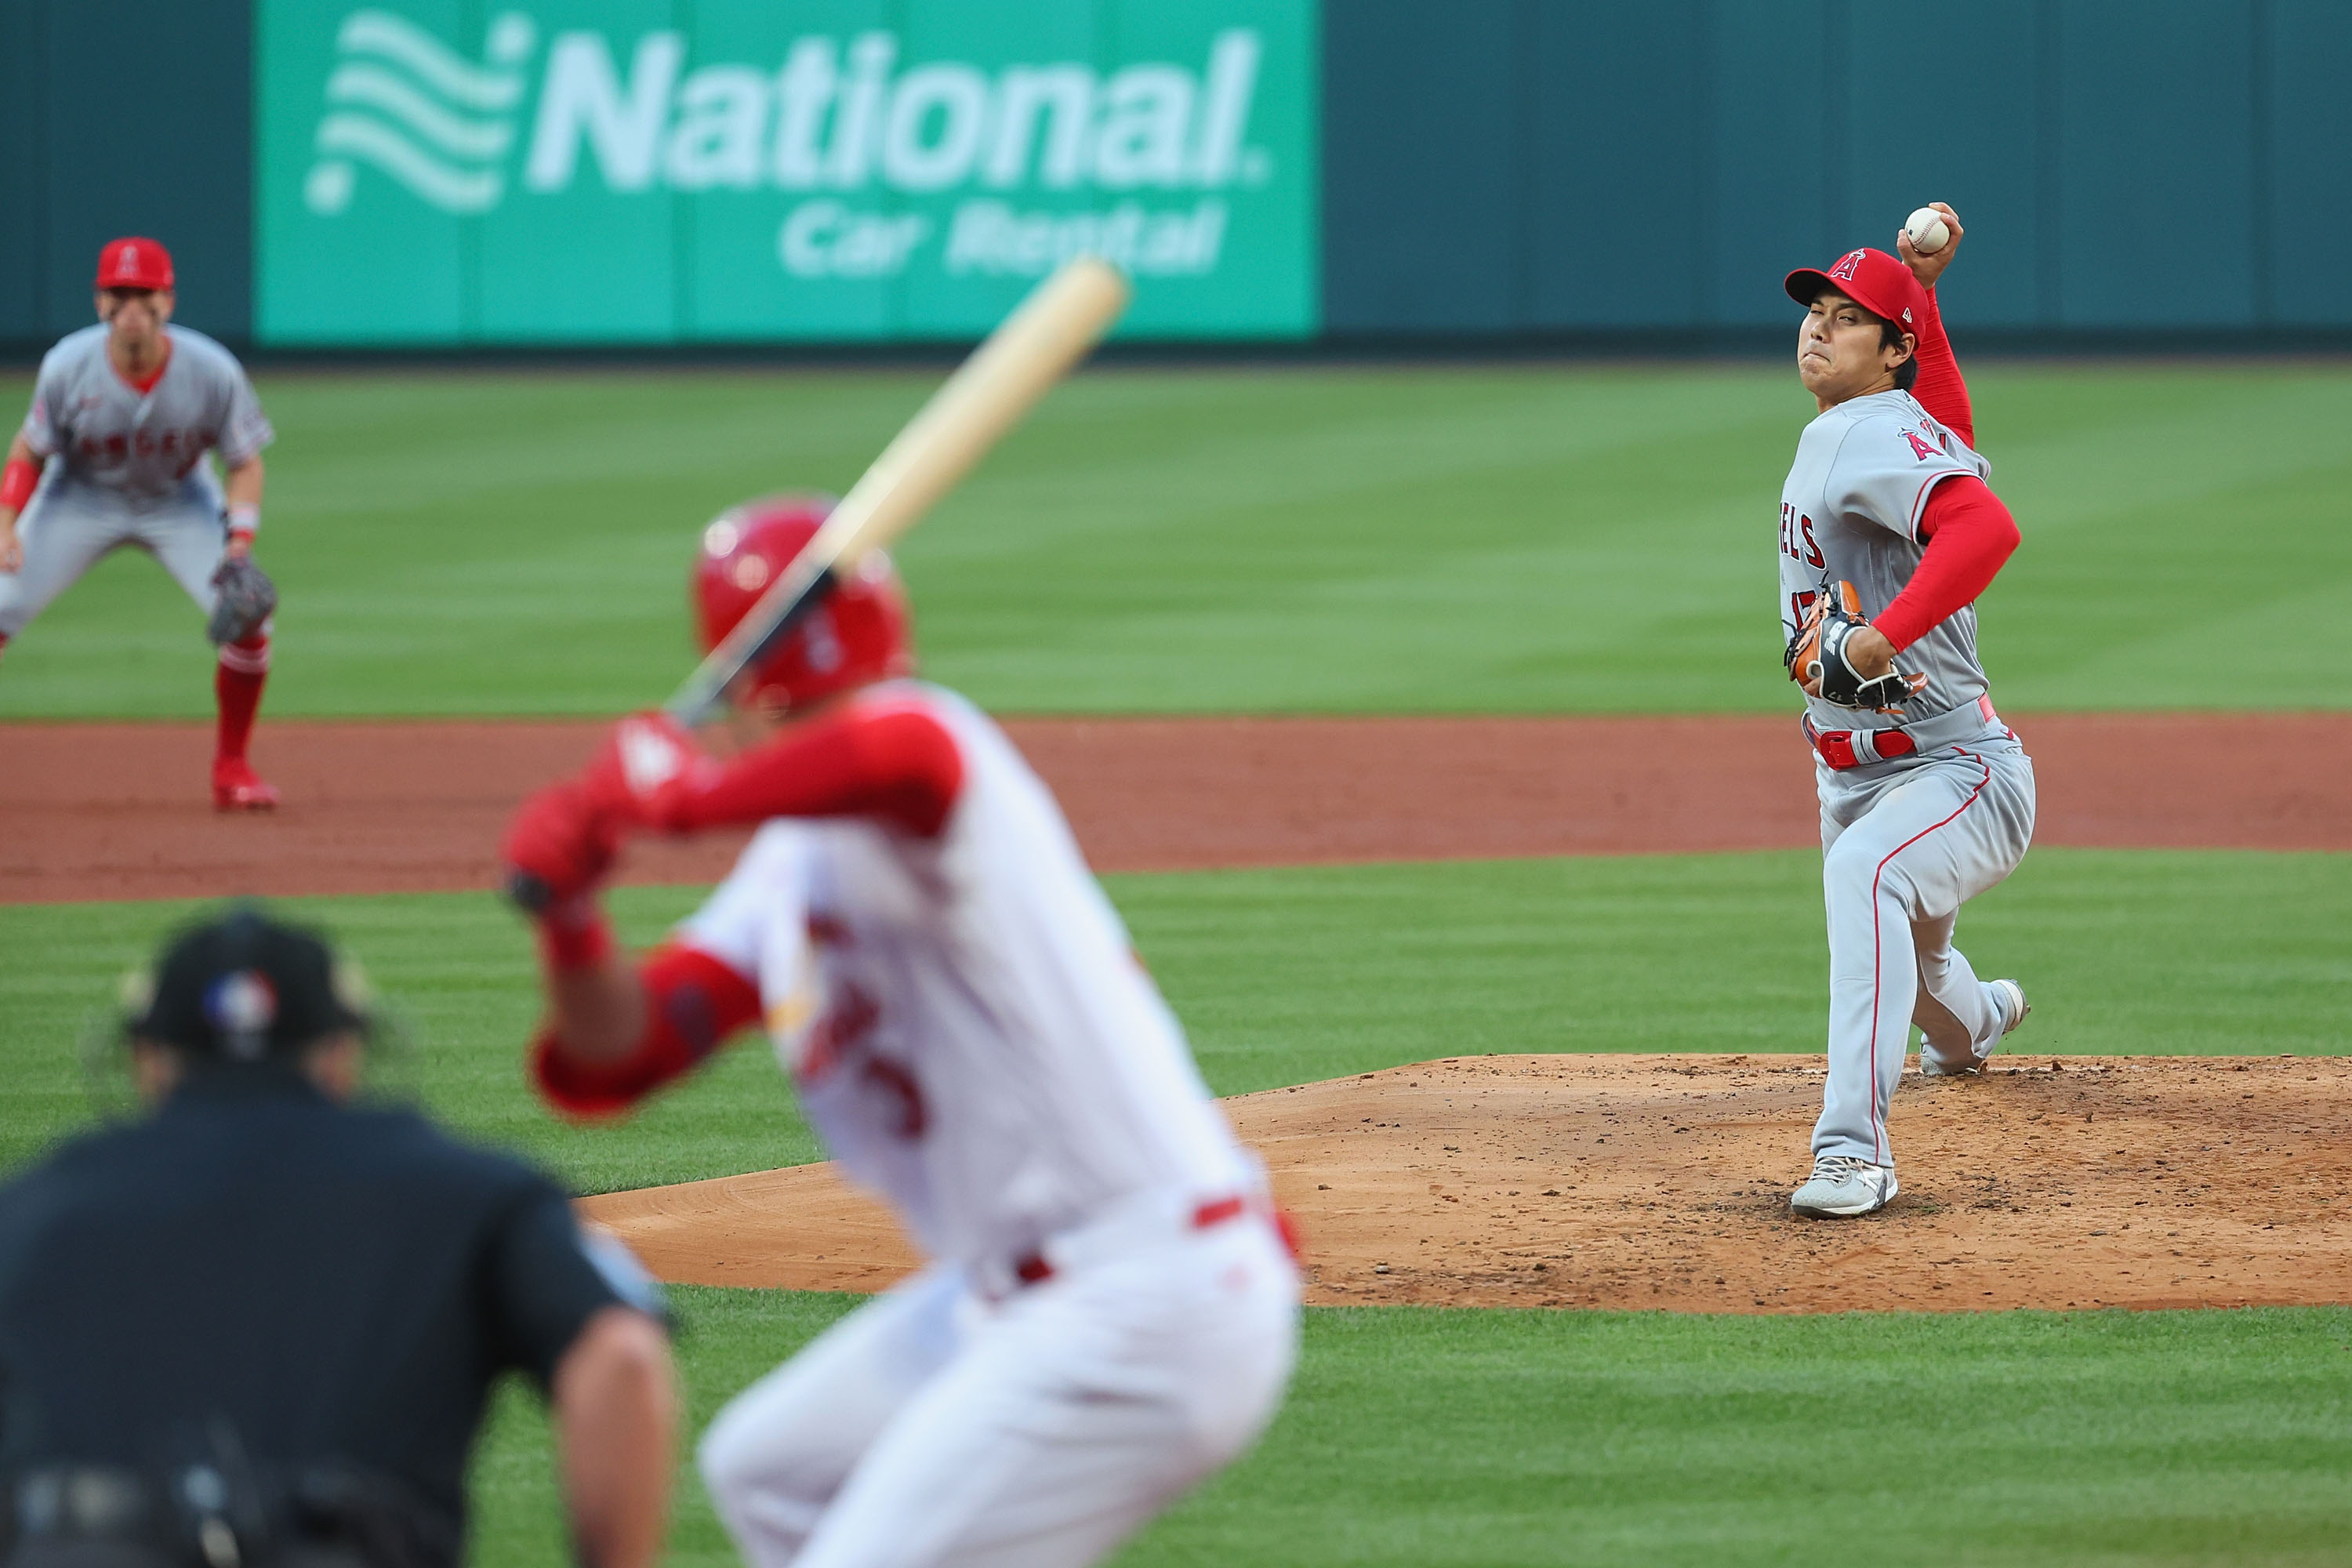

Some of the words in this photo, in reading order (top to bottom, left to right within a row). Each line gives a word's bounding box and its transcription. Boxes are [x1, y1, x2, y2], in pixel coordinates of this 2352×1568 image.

[527, 30, 1262, 192] National
[779, 198, 928, 277] Car
[946, 198, 1228, 278] Rental
[1831, 248, 1866, 281] A
[1897, 427, 1945, 462] A
[1779, 501, 1827, 570] ELS
